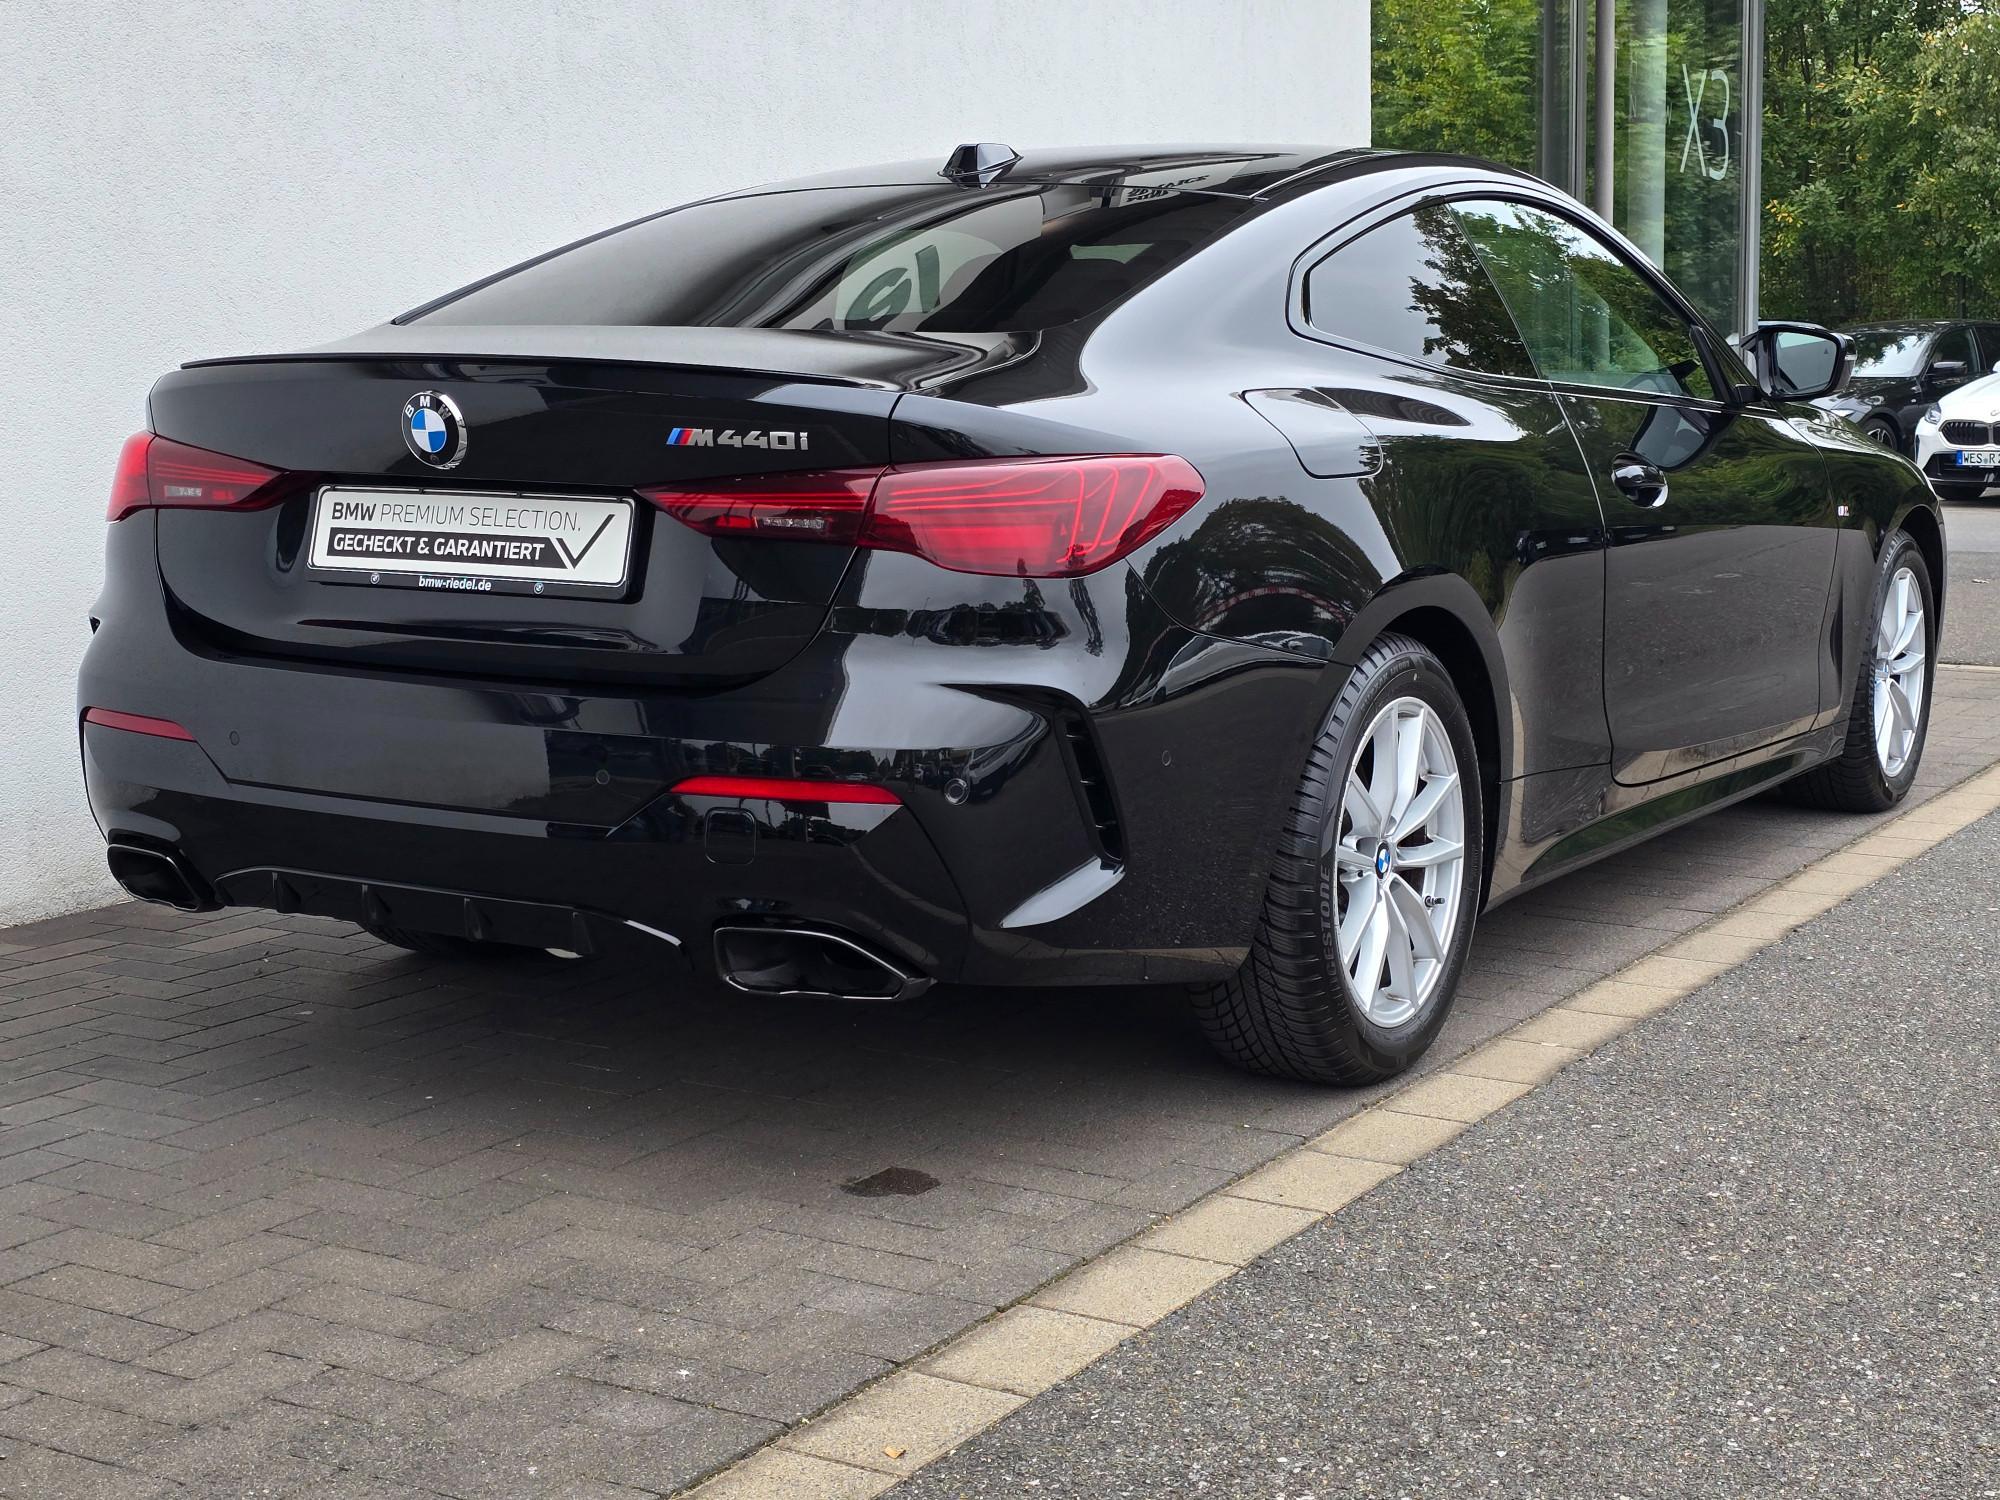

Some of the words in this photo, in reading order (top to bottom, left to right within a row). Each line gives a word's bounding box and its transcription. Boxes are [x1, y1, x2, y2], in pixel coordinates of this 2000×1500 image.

[1680, 63, 1730, 180] X3
[405, 395, 452, 420] BMW
[686, 428, 808, 450] M440i
[1963, 453, 1983, 464] WES
[332, 502, 376, 521] BMW
[380, 503, 464, 526] PREMIUM
[469, 506, 582, 532] SELECTION.
[333, 533, 416, 554] GECHECKT
[417, 537, 430, 555] &
[433, 537, 545, 561] GARANTIERT
[418, 575, 492, 591] bmw-riedel.de
